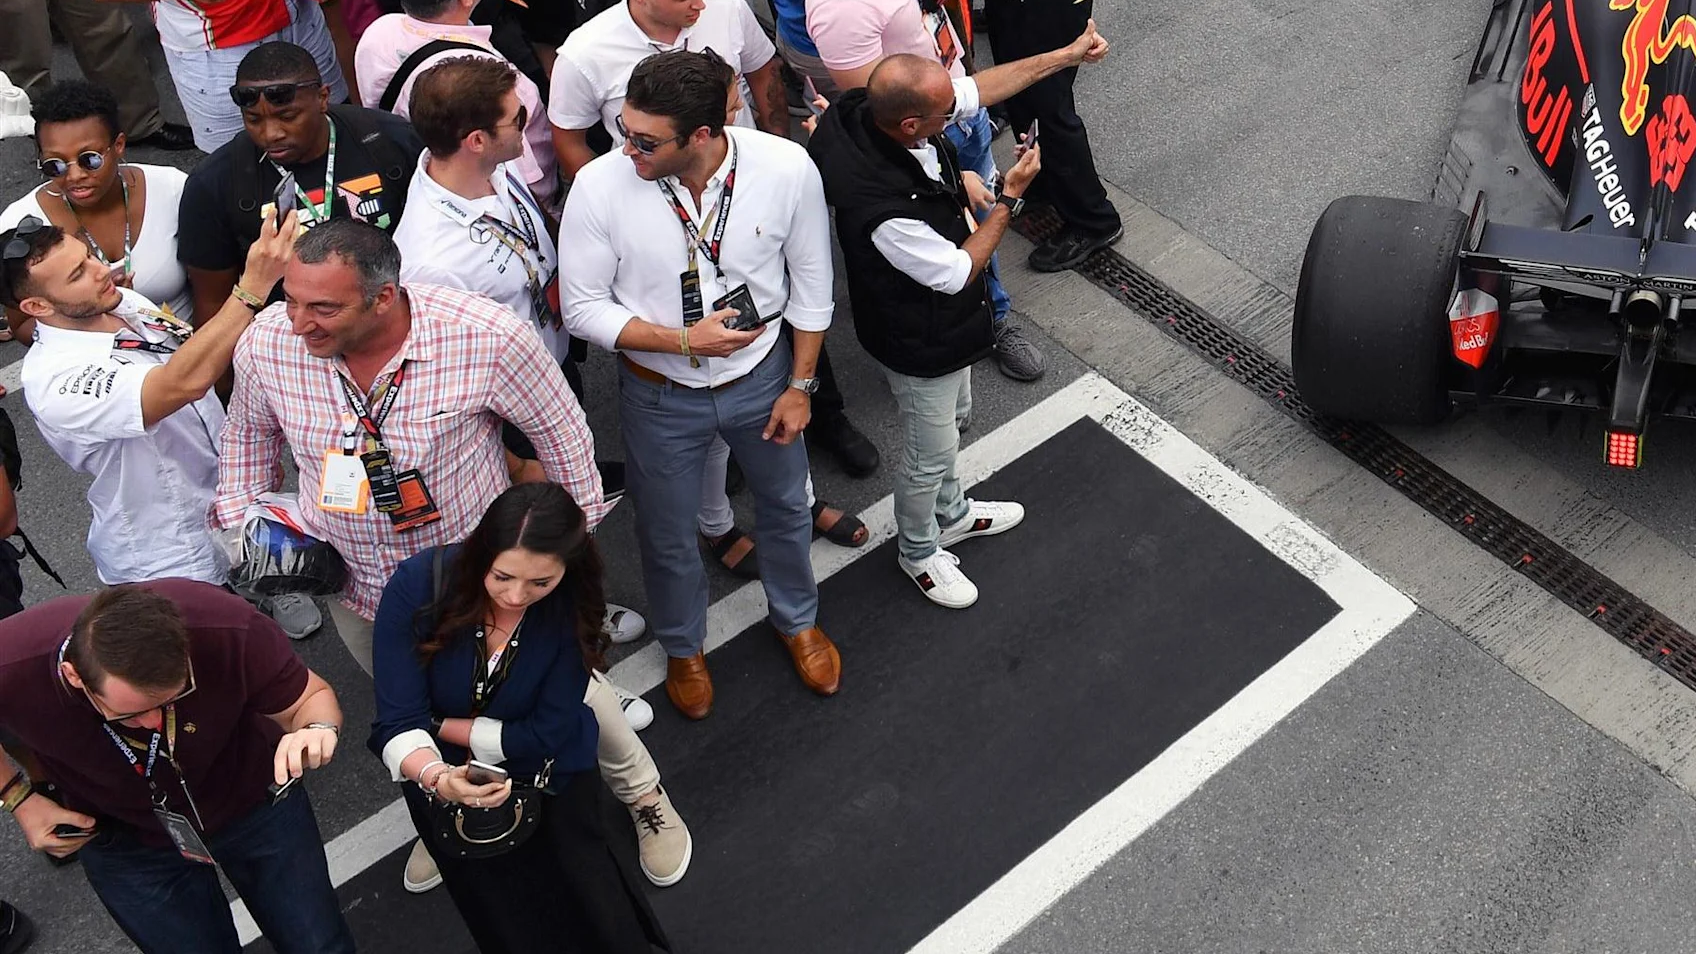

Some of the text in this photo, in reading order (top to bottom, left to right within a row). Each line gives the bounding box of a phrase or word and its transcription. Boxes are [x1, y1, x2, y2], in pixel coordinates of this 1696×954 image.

[714, 196, 730, 242] Experiences
[1584, 274, 1693, 290] ASTON MARTIN
